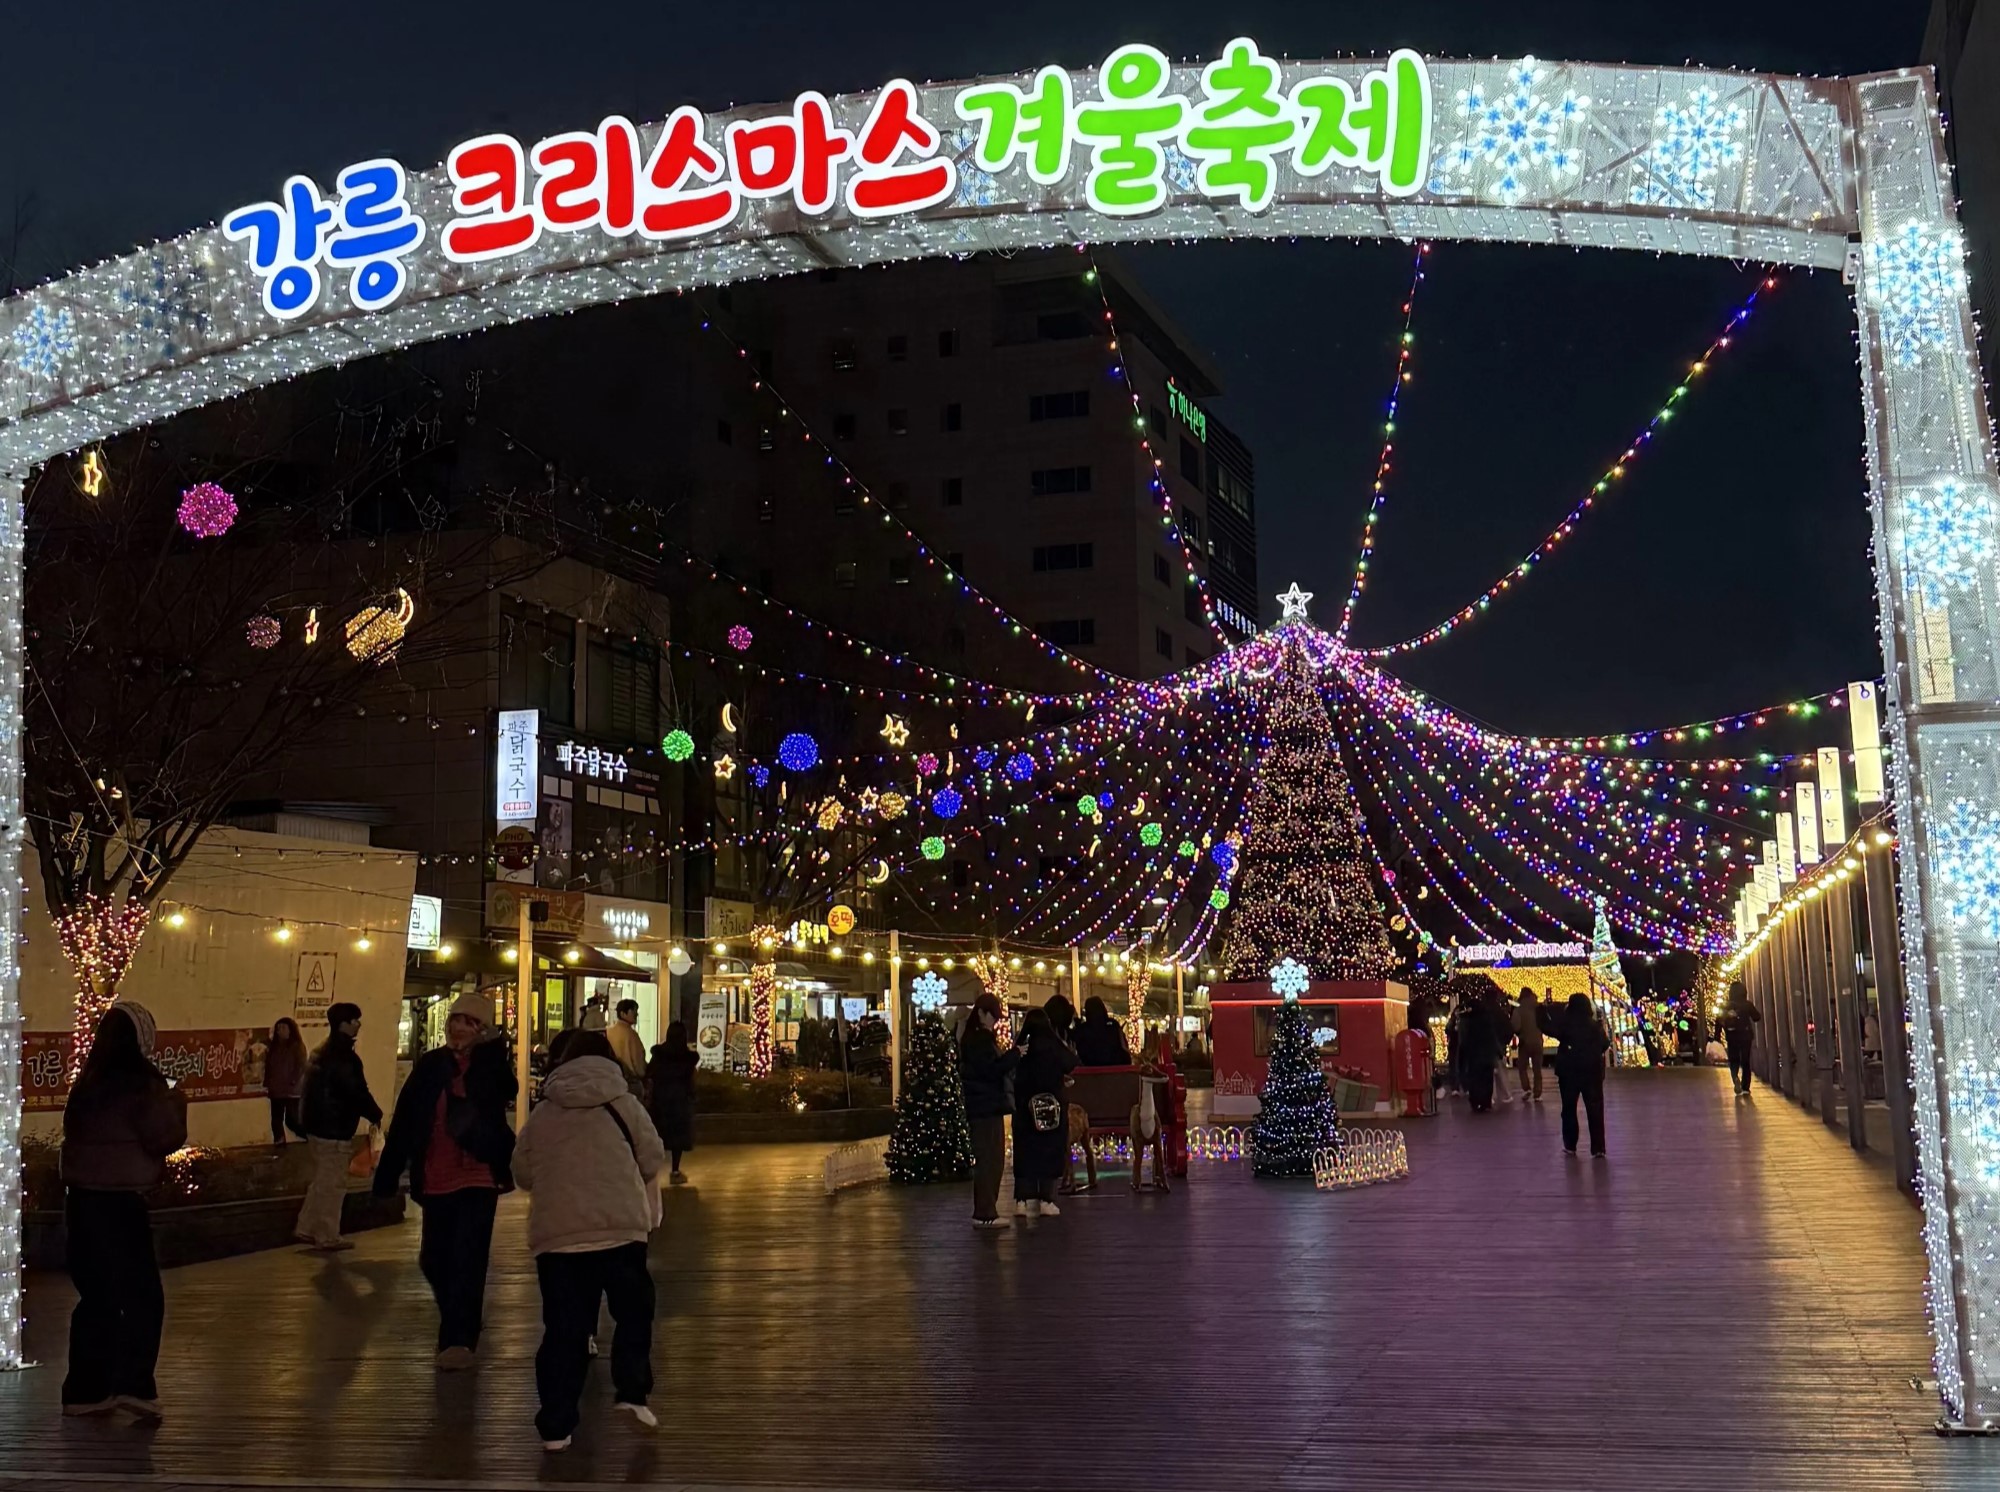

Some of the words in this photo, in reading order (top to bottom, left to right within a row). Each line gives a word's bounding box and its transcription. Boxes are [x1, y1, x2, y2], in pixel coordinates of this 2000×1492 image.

[222, 158, 426, 319] 강릉
[441, 78, 956, 263] 크리스마스
[955, 36, 1433, 214] 겨울축제
[1177, 390, 1207, 444] 하나은행
[507, 719, 529, 732] 파주
[508, 732, 528, 799] 닭국수
[556, 741, 629, 782] 파주닭국수
[830, 911, 853, 927] 호떡
[1458, 944, 1508, 960] MERRY
[1511, 942, 1586, 958] CHRISTMAS
[26, 1049, 63, 1087] 강릉
